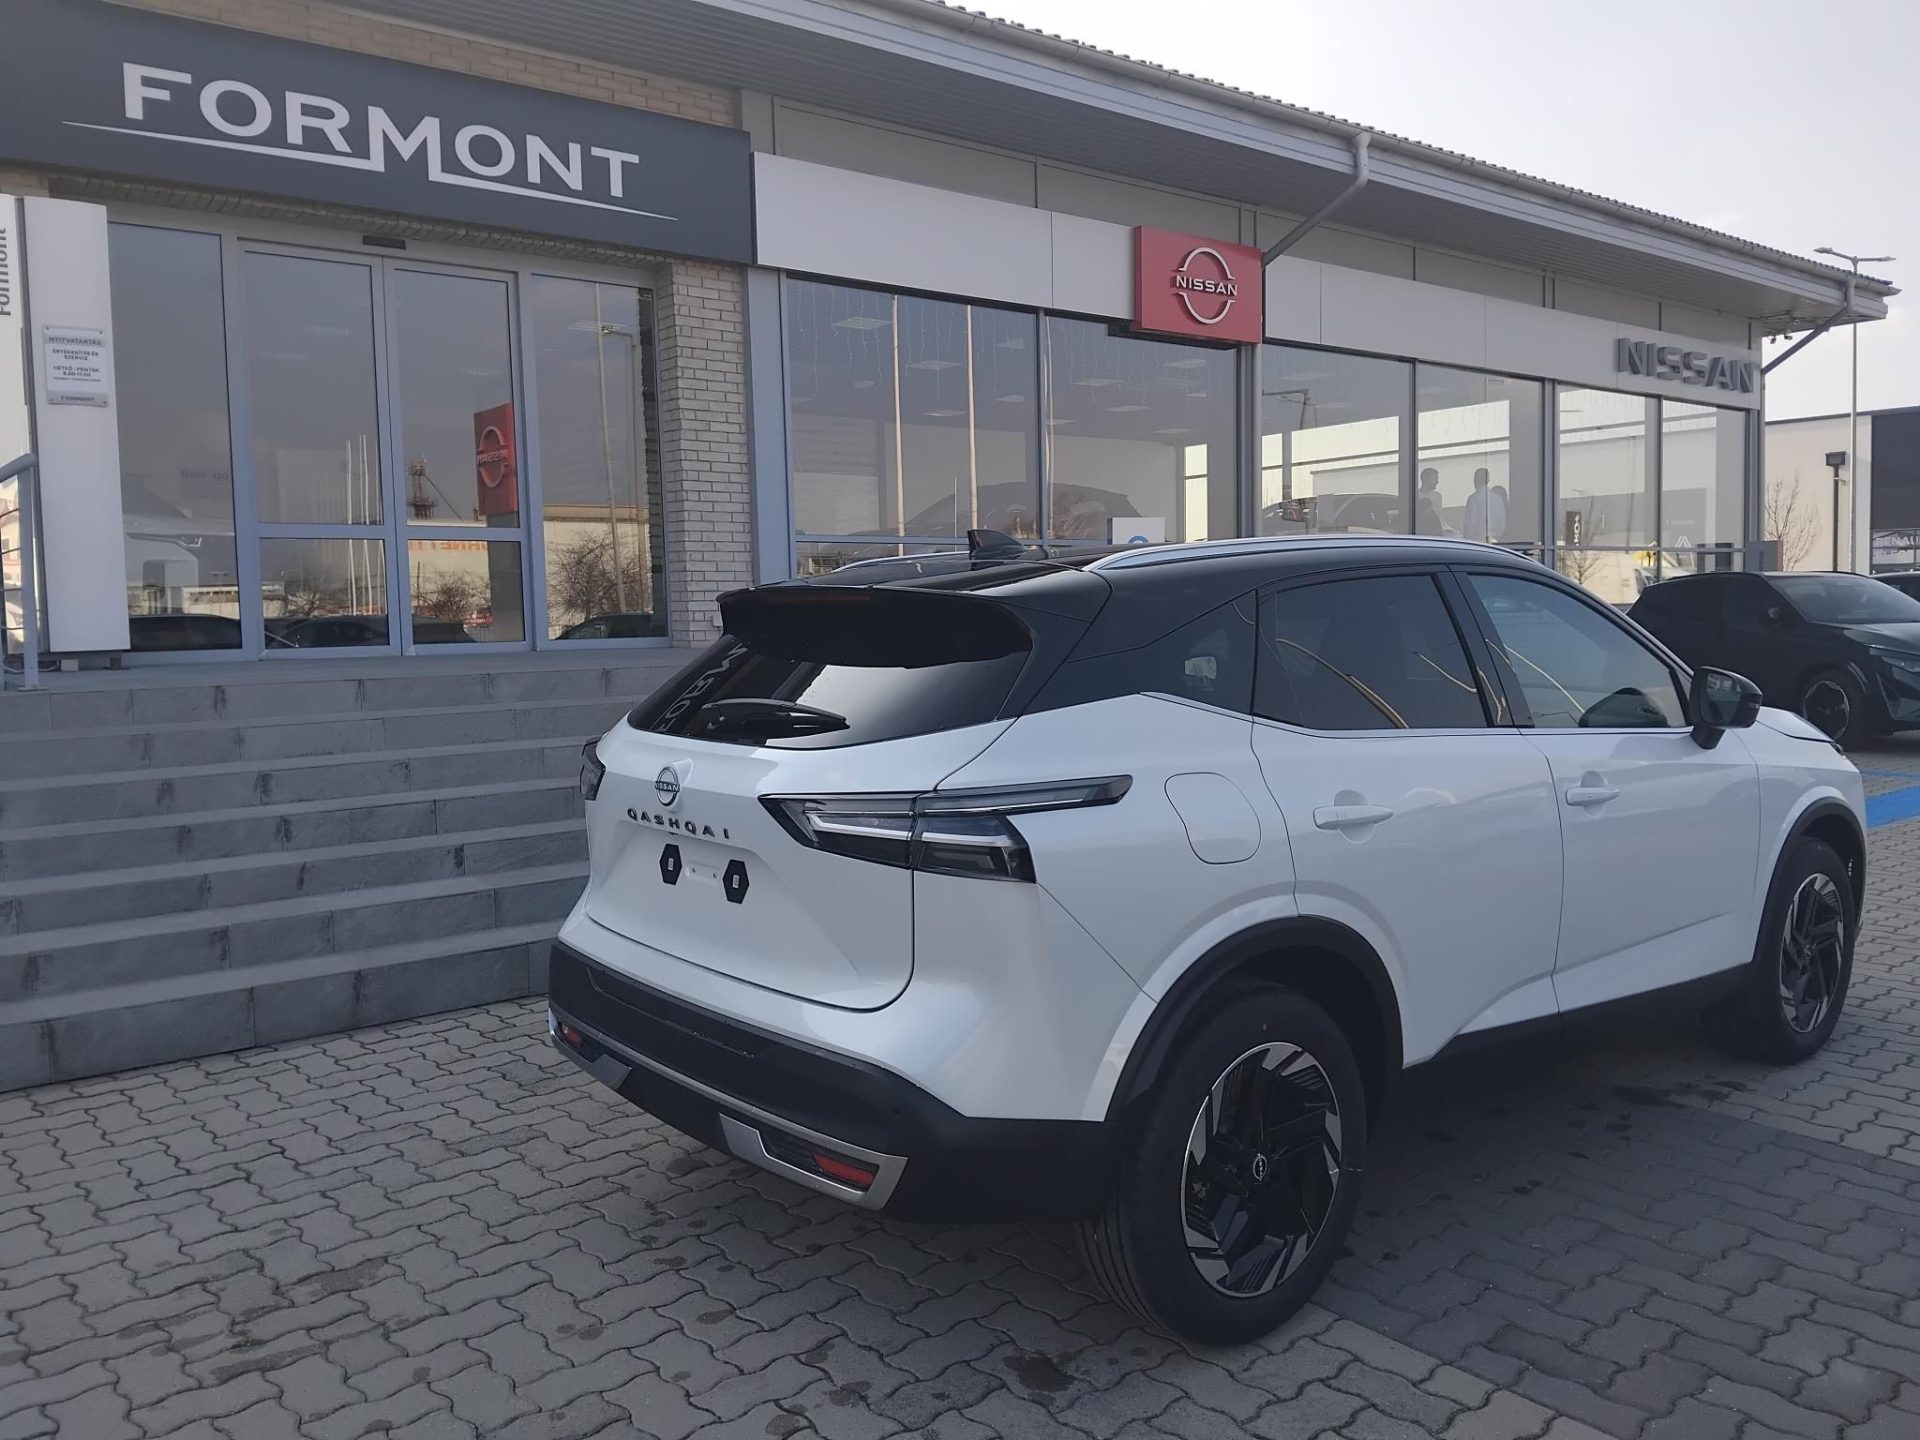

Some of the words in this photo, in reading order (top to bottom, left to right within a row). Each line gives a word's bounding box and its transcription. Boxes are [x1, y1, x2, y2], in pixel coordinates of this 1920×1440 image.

[122, 61, 640, 199] FORMONT
[1176, 275, 1238, 296] NISSAN
[1616, 337, 1755, 393] NISSAN
[1875, 536, 1920, 547] RENAU
[654, 781, 681, 793] NISSAN
[627, 807, 731, 840] QASHQAI
